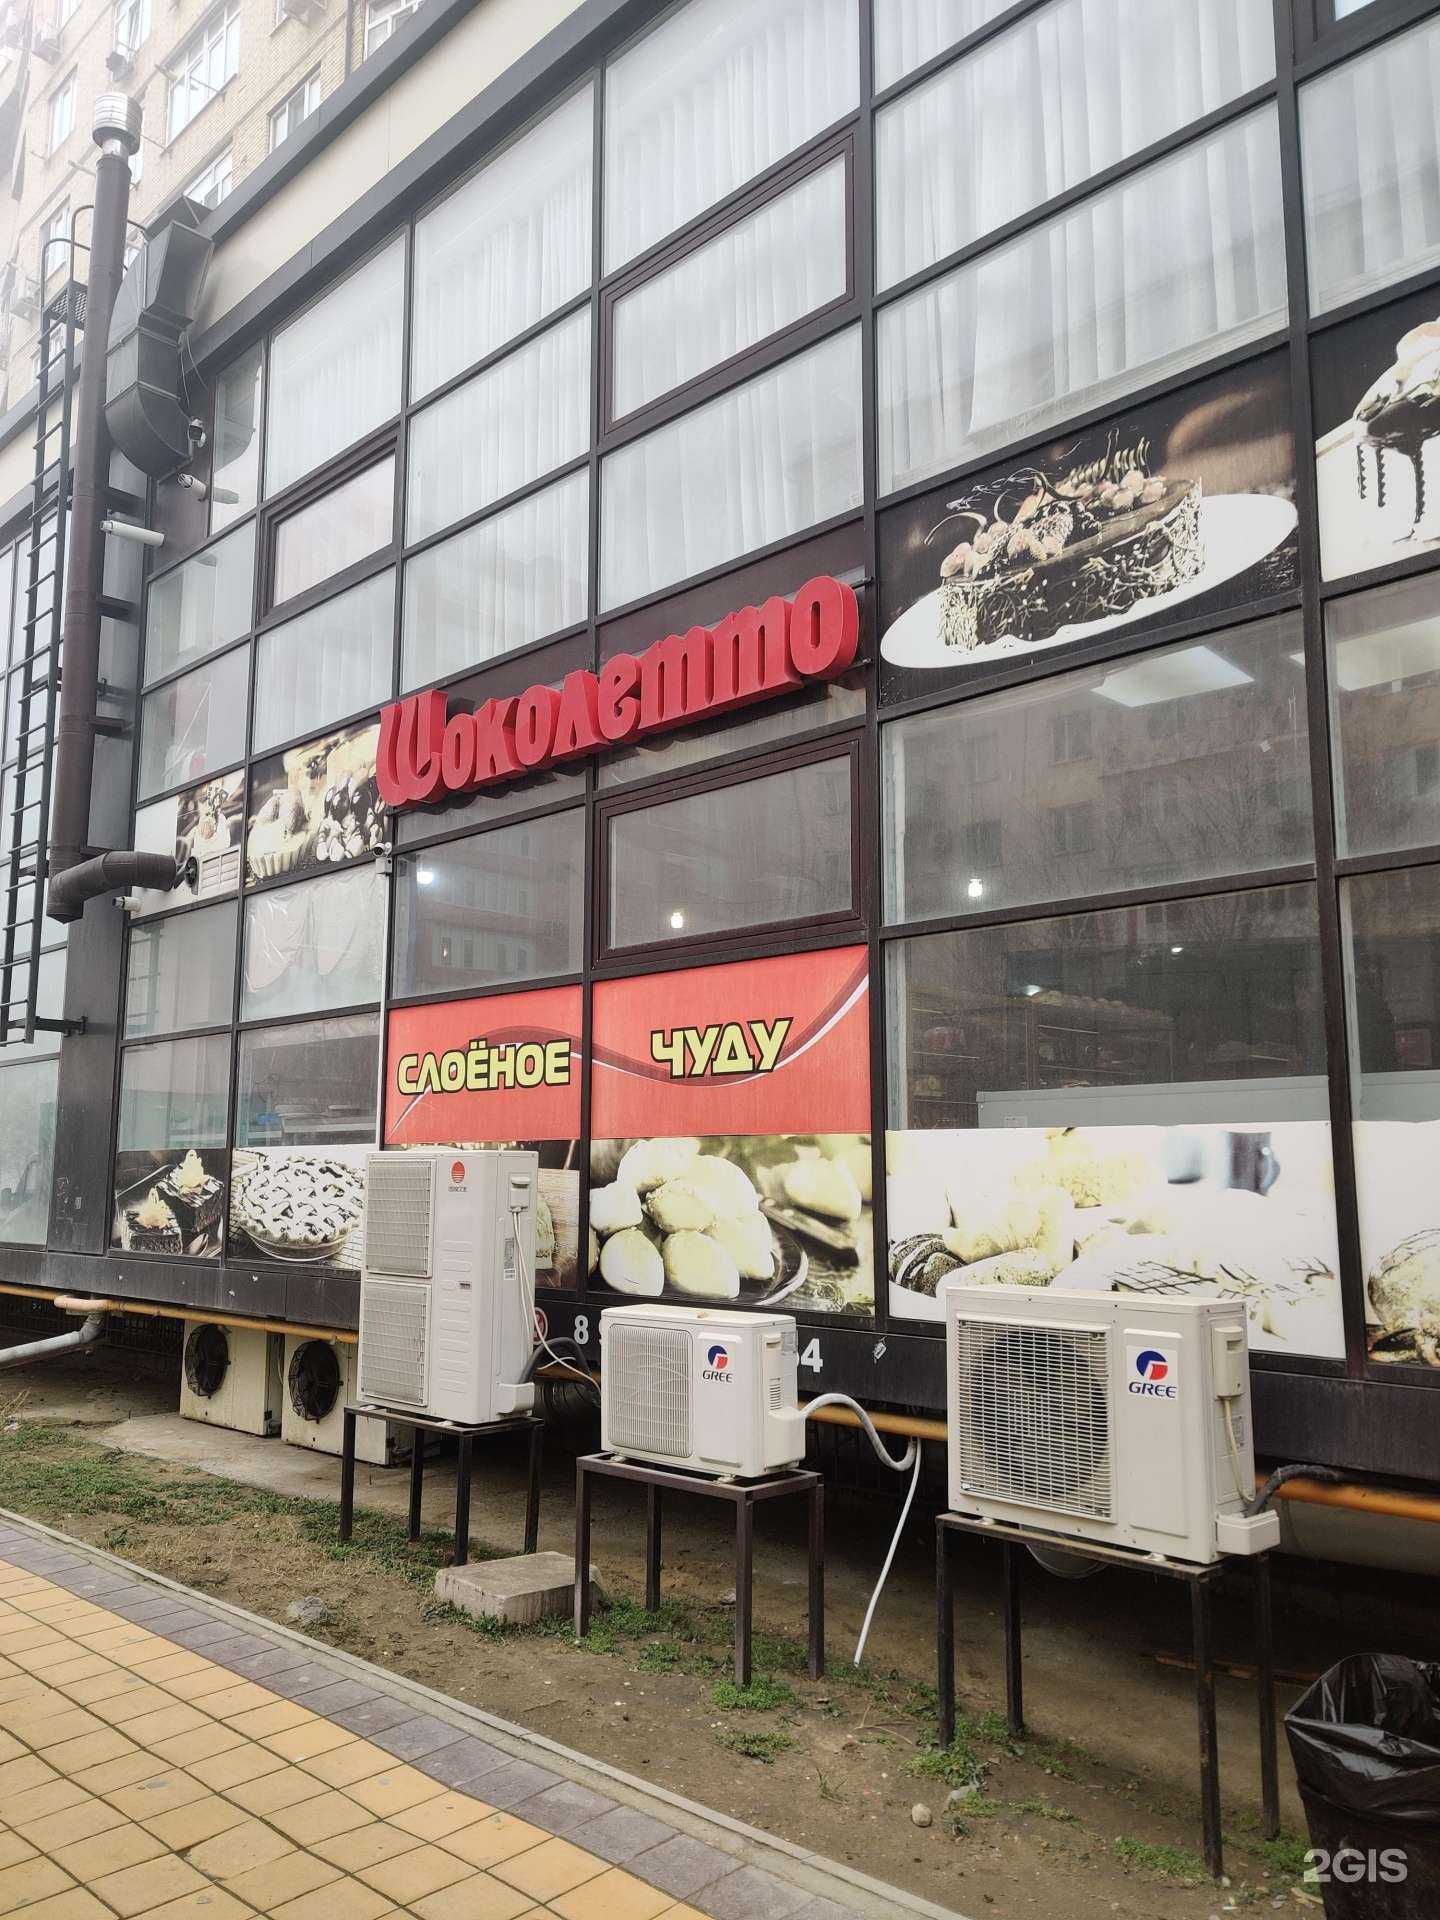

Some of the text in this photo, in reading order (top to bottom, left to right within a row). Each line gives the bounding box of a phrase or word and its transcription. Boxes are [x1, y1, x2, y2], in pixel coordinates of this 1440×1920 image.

[376, 576, 859, 806] Шоколетто
[397, 1017, 793, 1094] СЛОЁНОЕ ЧУДУ
[574, 1315, 589, 1345] 8
[702, 1370, 734, 1383] GREE
[1128, 1381, 1177, 1398] GREE
